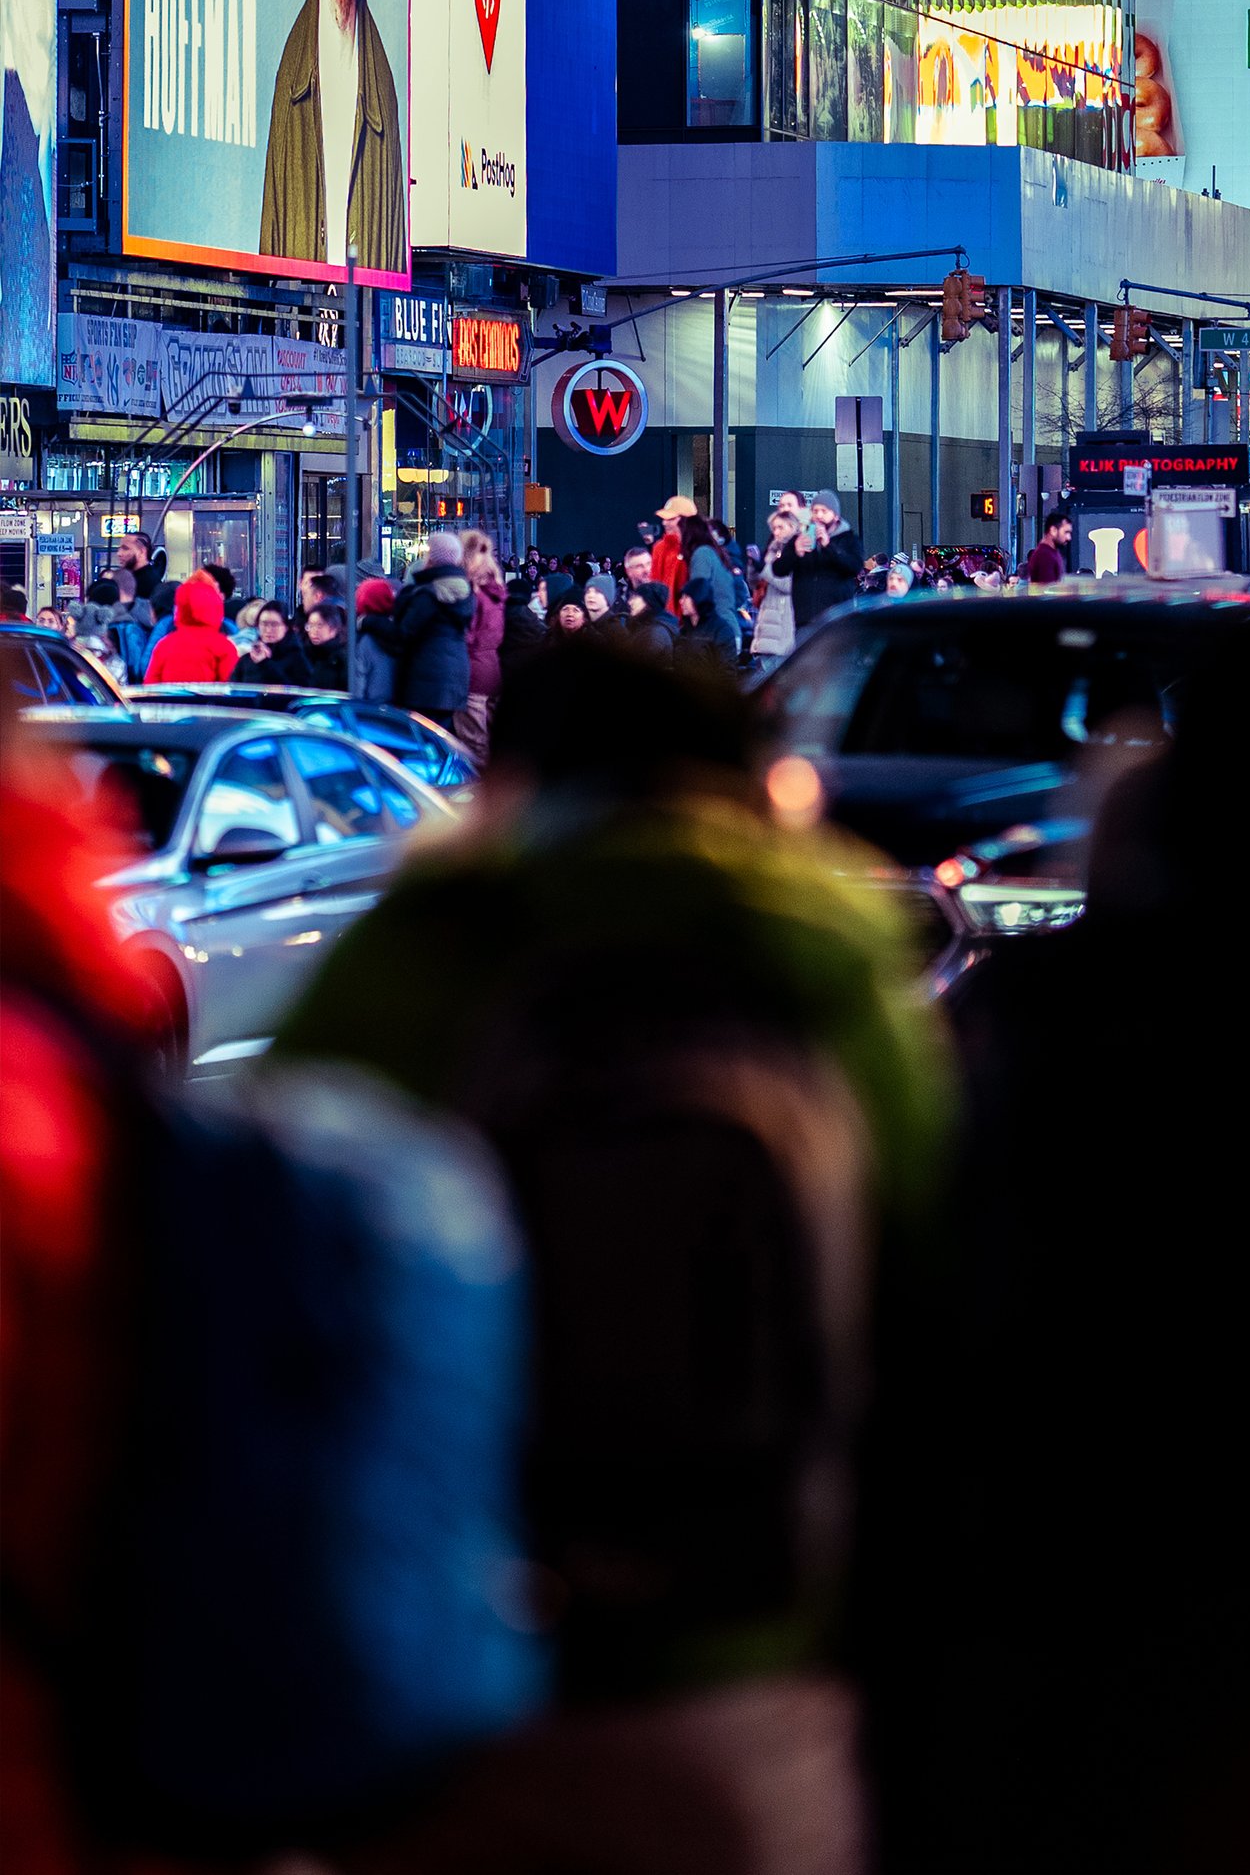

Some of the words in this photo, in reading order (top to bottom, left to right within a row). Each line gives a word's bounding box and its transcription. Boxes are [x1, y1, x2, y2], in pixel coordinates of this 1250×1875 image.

[481, 148, 516, 198] PostHog
[395, 297, 427, 342] BLUE
[1223, 333, 1235, 346] W
[580, 388, 632, 438] W
[1079, 460, 1114, 472] KLIK
